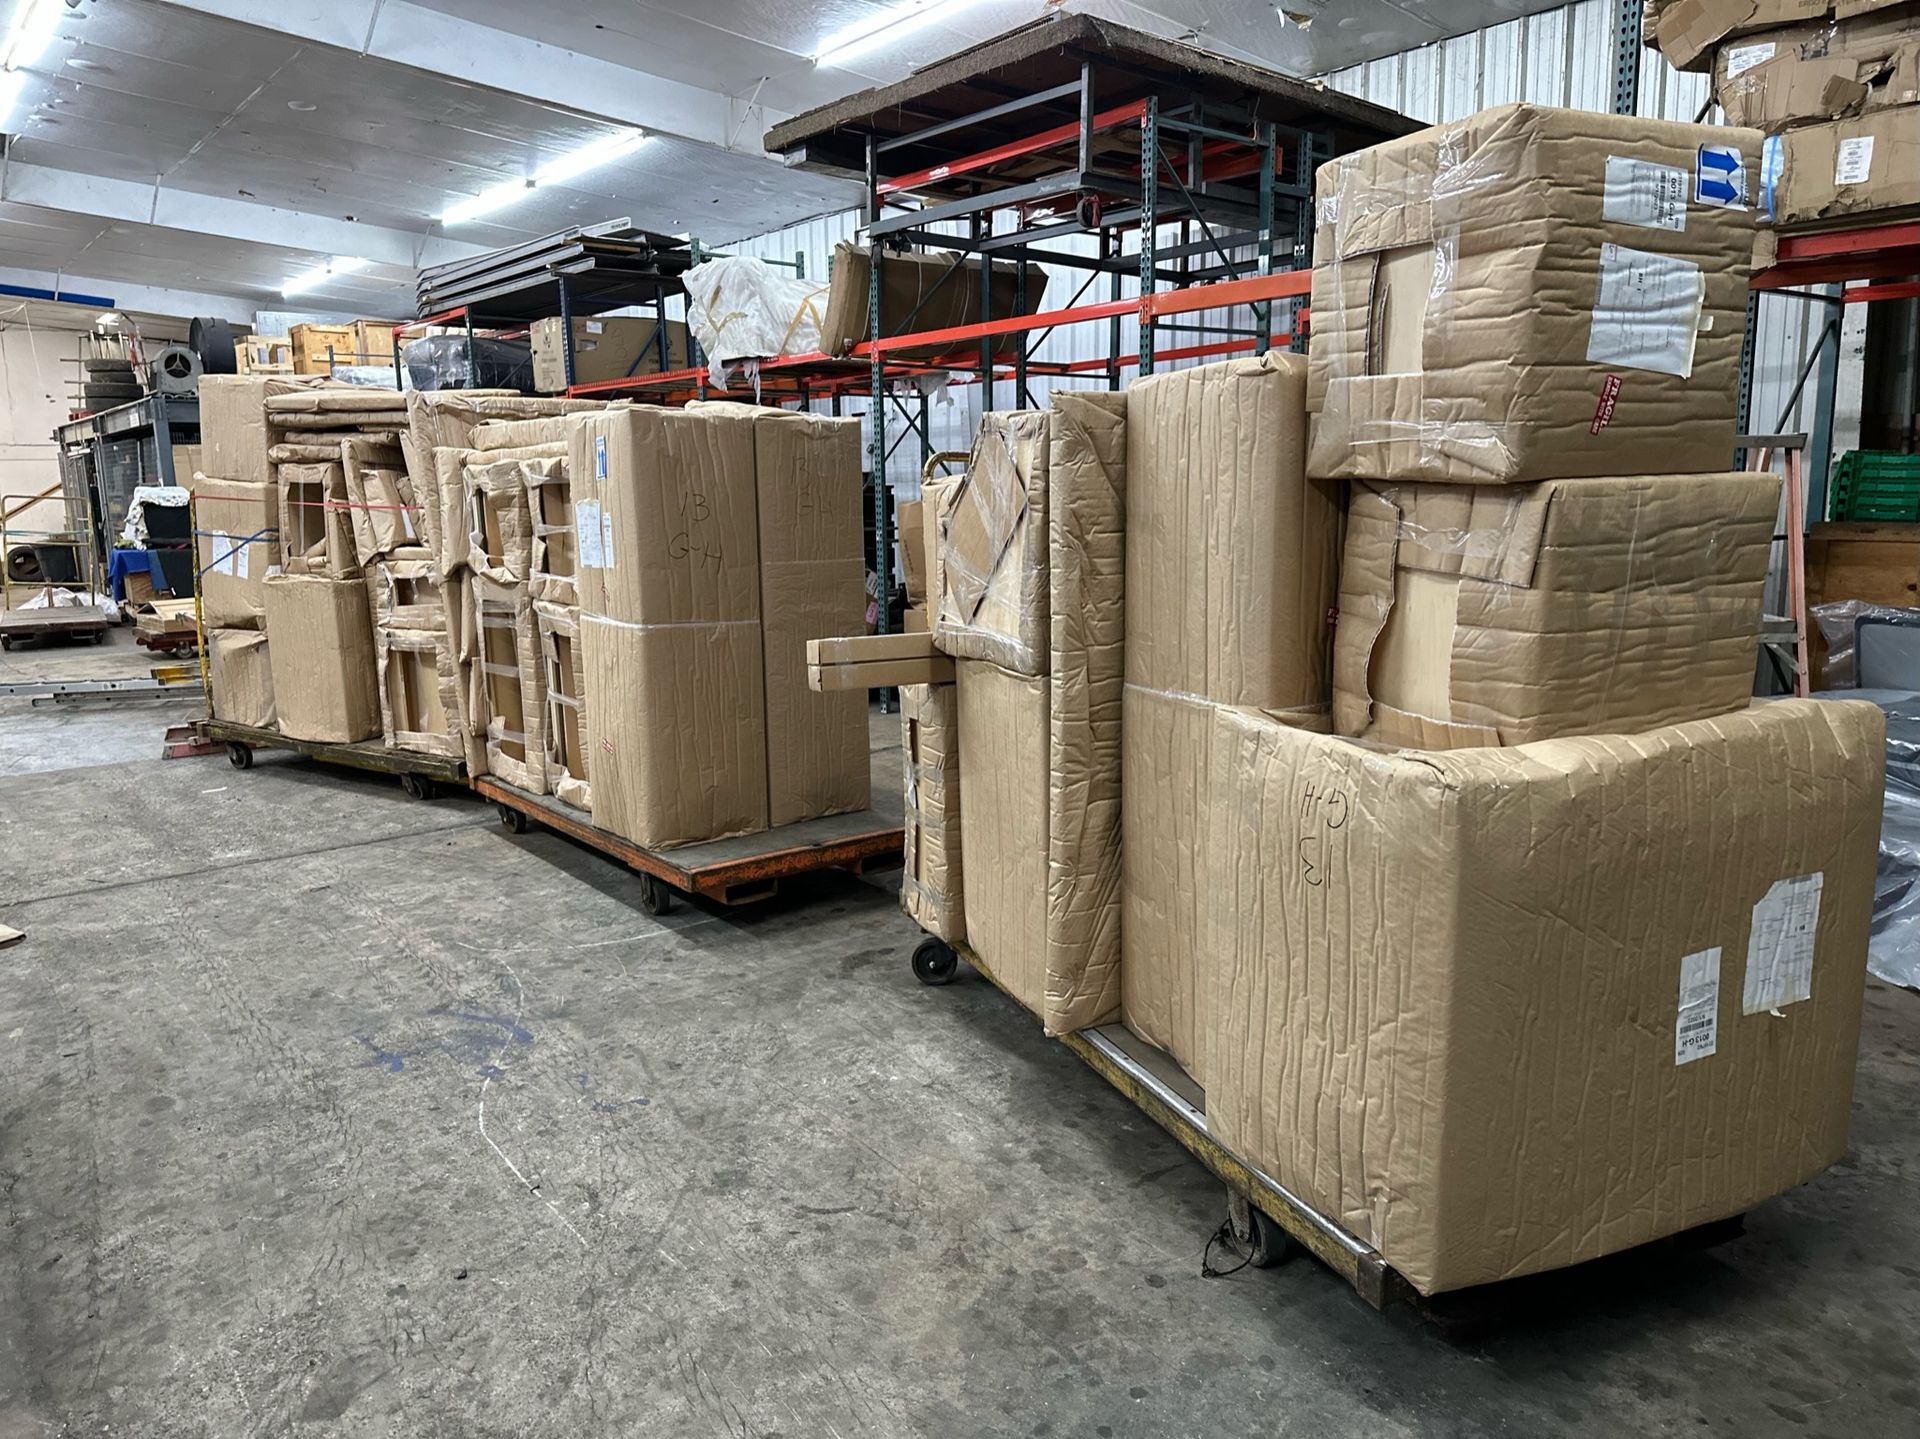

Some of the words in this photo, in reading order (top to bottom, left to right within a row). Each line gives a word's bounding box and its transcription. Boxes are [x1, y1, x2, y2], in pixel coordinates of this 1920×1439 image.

[1669, 177, 1677, 200] 0013
[1666, 202, 1675, 222] G-H
[1597, 378, 1621, 434] FRAGIL
[668, 531, 722, 576] G-H
[1300, 781, 1348, 829] G-H
[1299, 836, 1333, 889] 13
[1695, 1032, 1710, 1044] 0013
